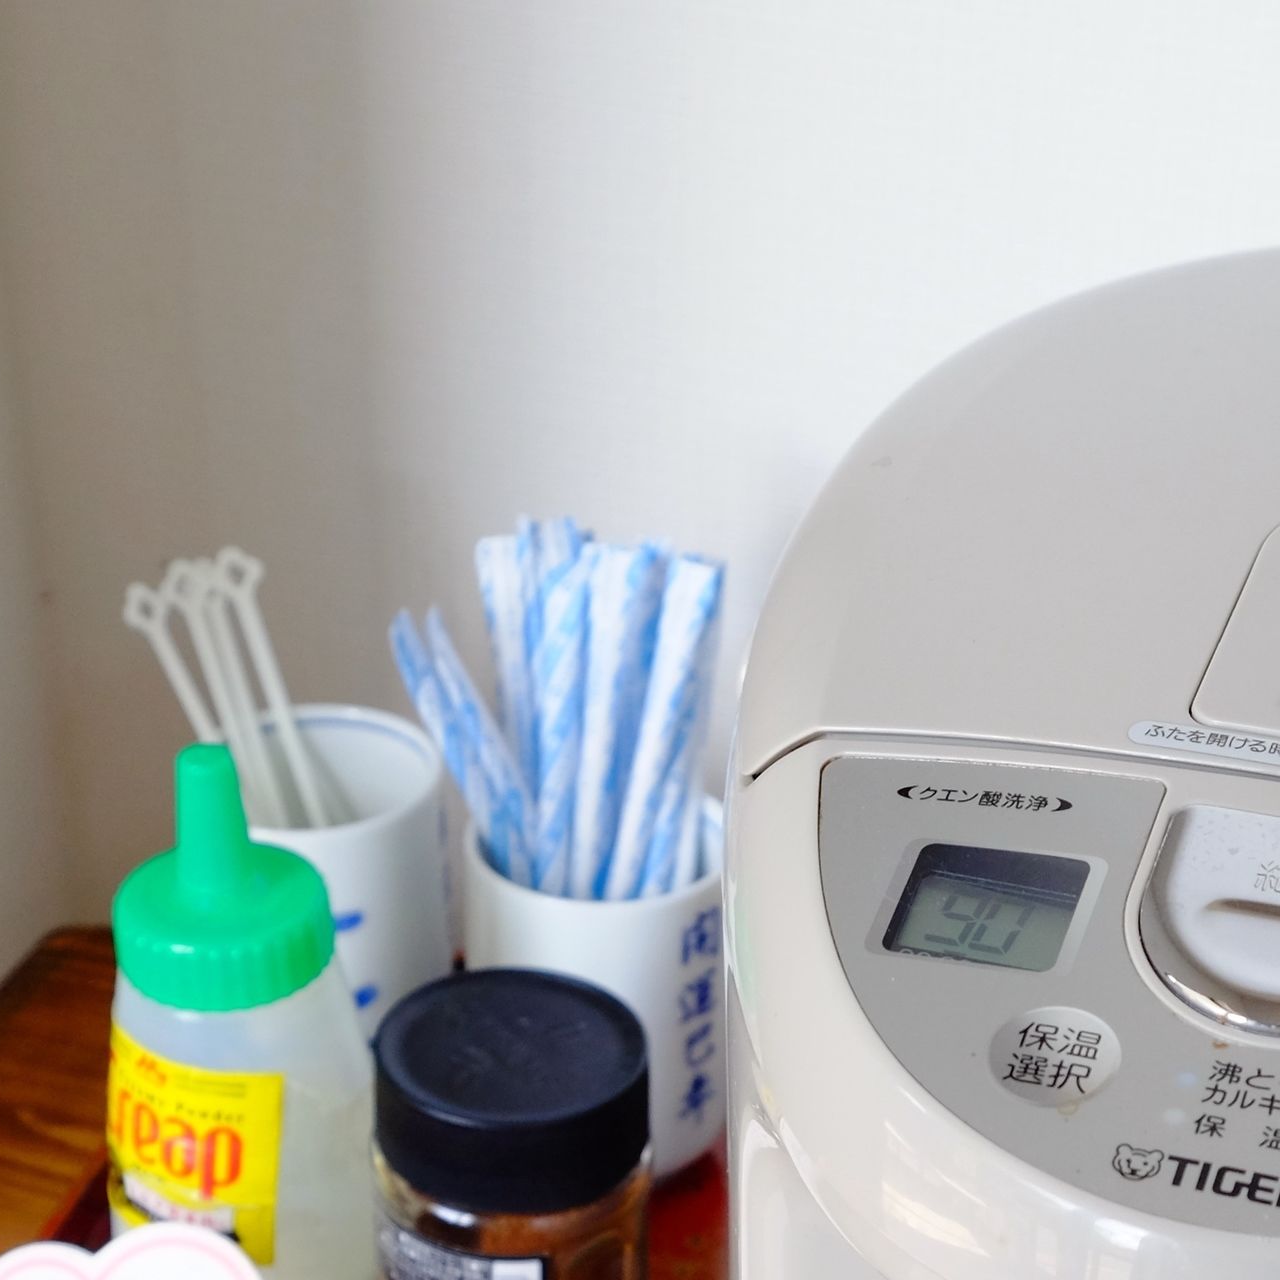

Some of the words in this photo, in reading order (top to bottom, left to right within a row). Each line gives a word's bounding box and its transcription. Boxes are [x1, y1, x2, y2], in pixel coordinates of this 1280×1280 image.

[920, 786, 1050, 812] クエン酸洗浄
[1018, 1021, 1103, 1061] 保温
[1002, 1052, 1092, 1095] 選択
[111, 1088, 244, 1201] reap
